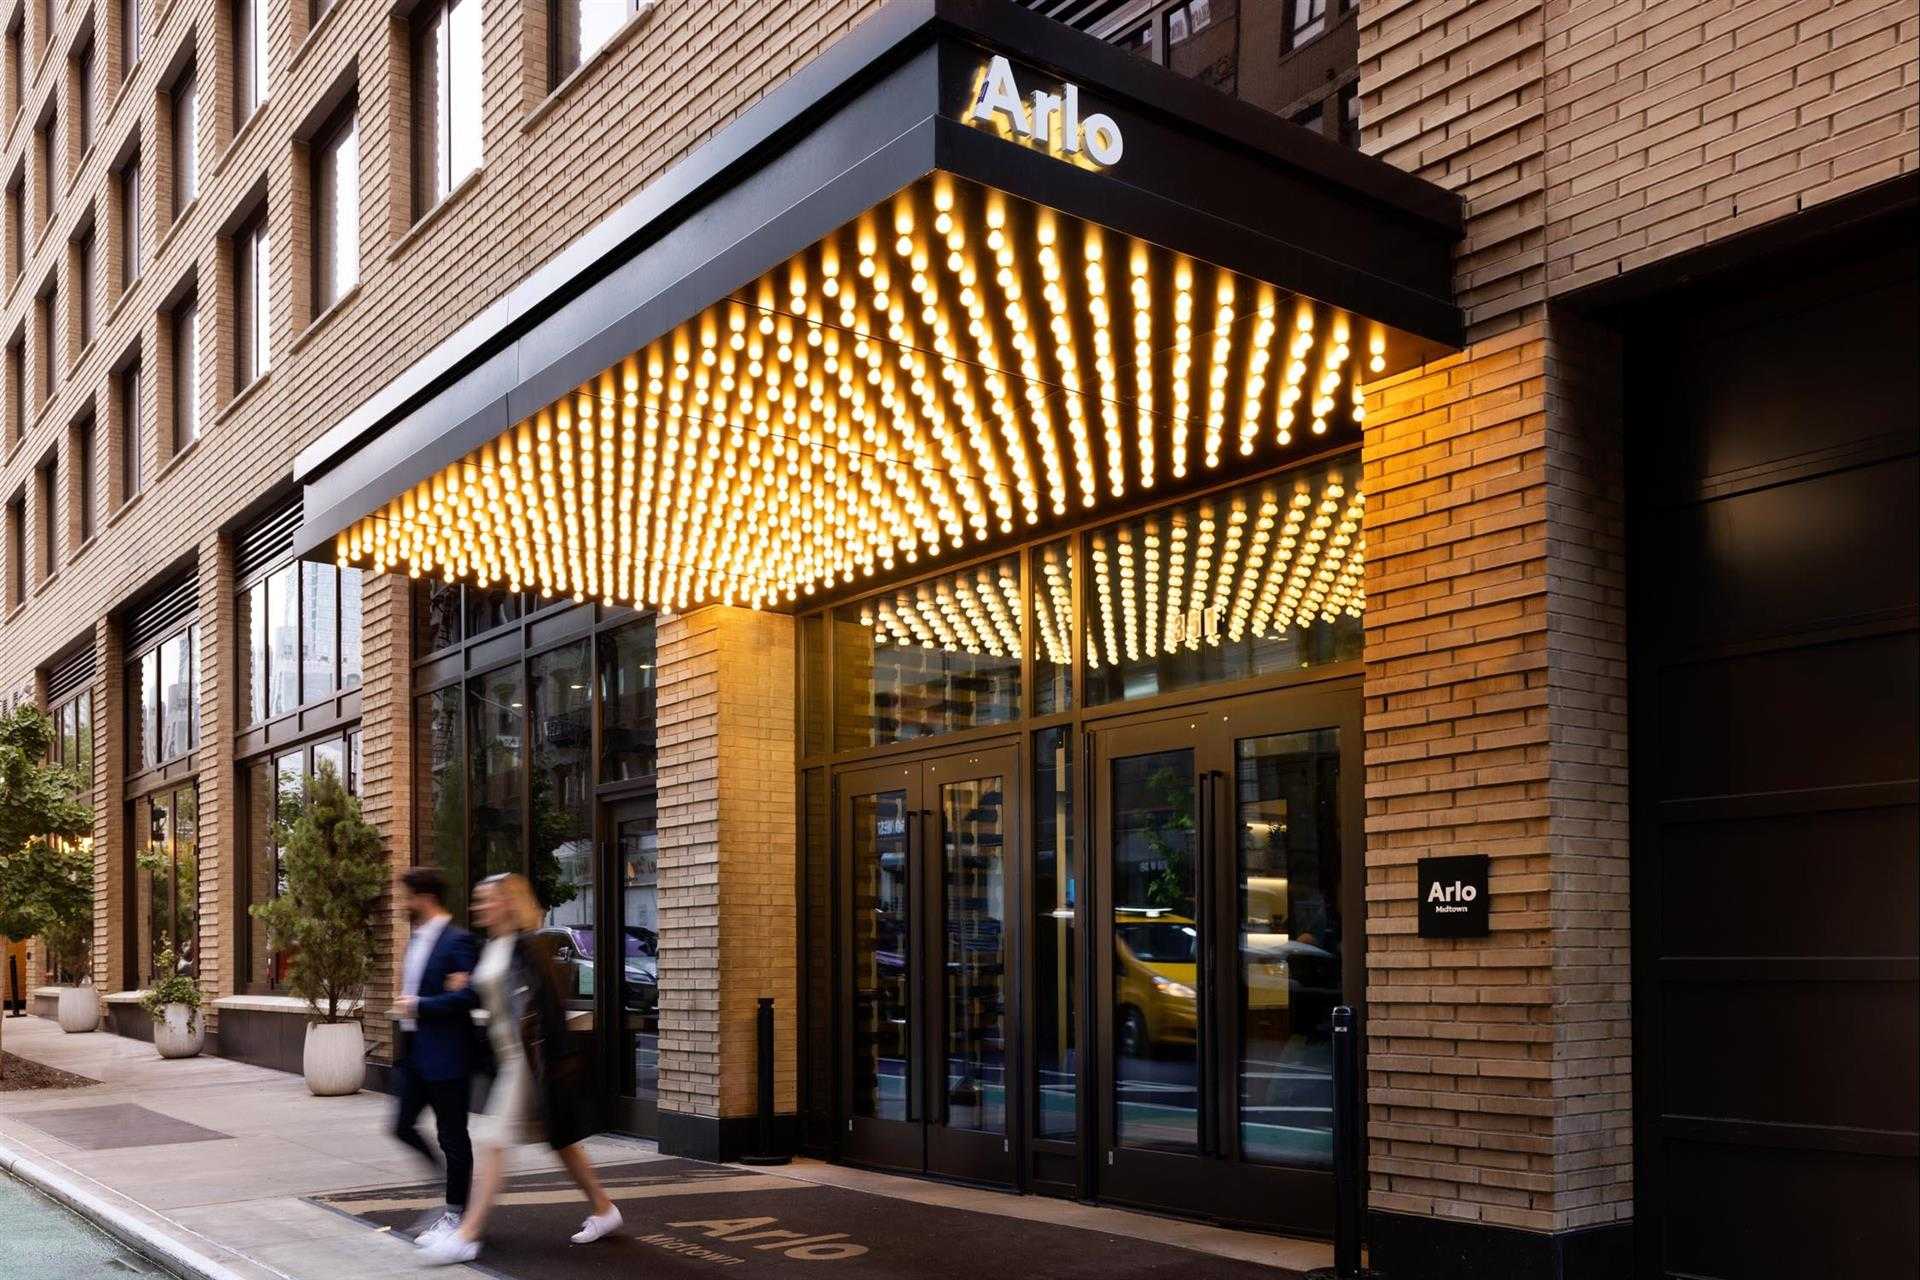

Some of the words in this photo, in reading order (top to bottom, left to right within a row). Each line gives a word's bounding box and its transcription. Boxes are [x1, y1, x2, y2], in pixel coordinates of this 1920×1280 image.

[972, 54, 1123, 165] Arlo
[1427, 881, 1477, 902] Arlo
[1435, 905, 1468, 913] Midtown
[634, 1233, 745, 1265] Midtown
[665, 1216, 869, 1260] Arlo
